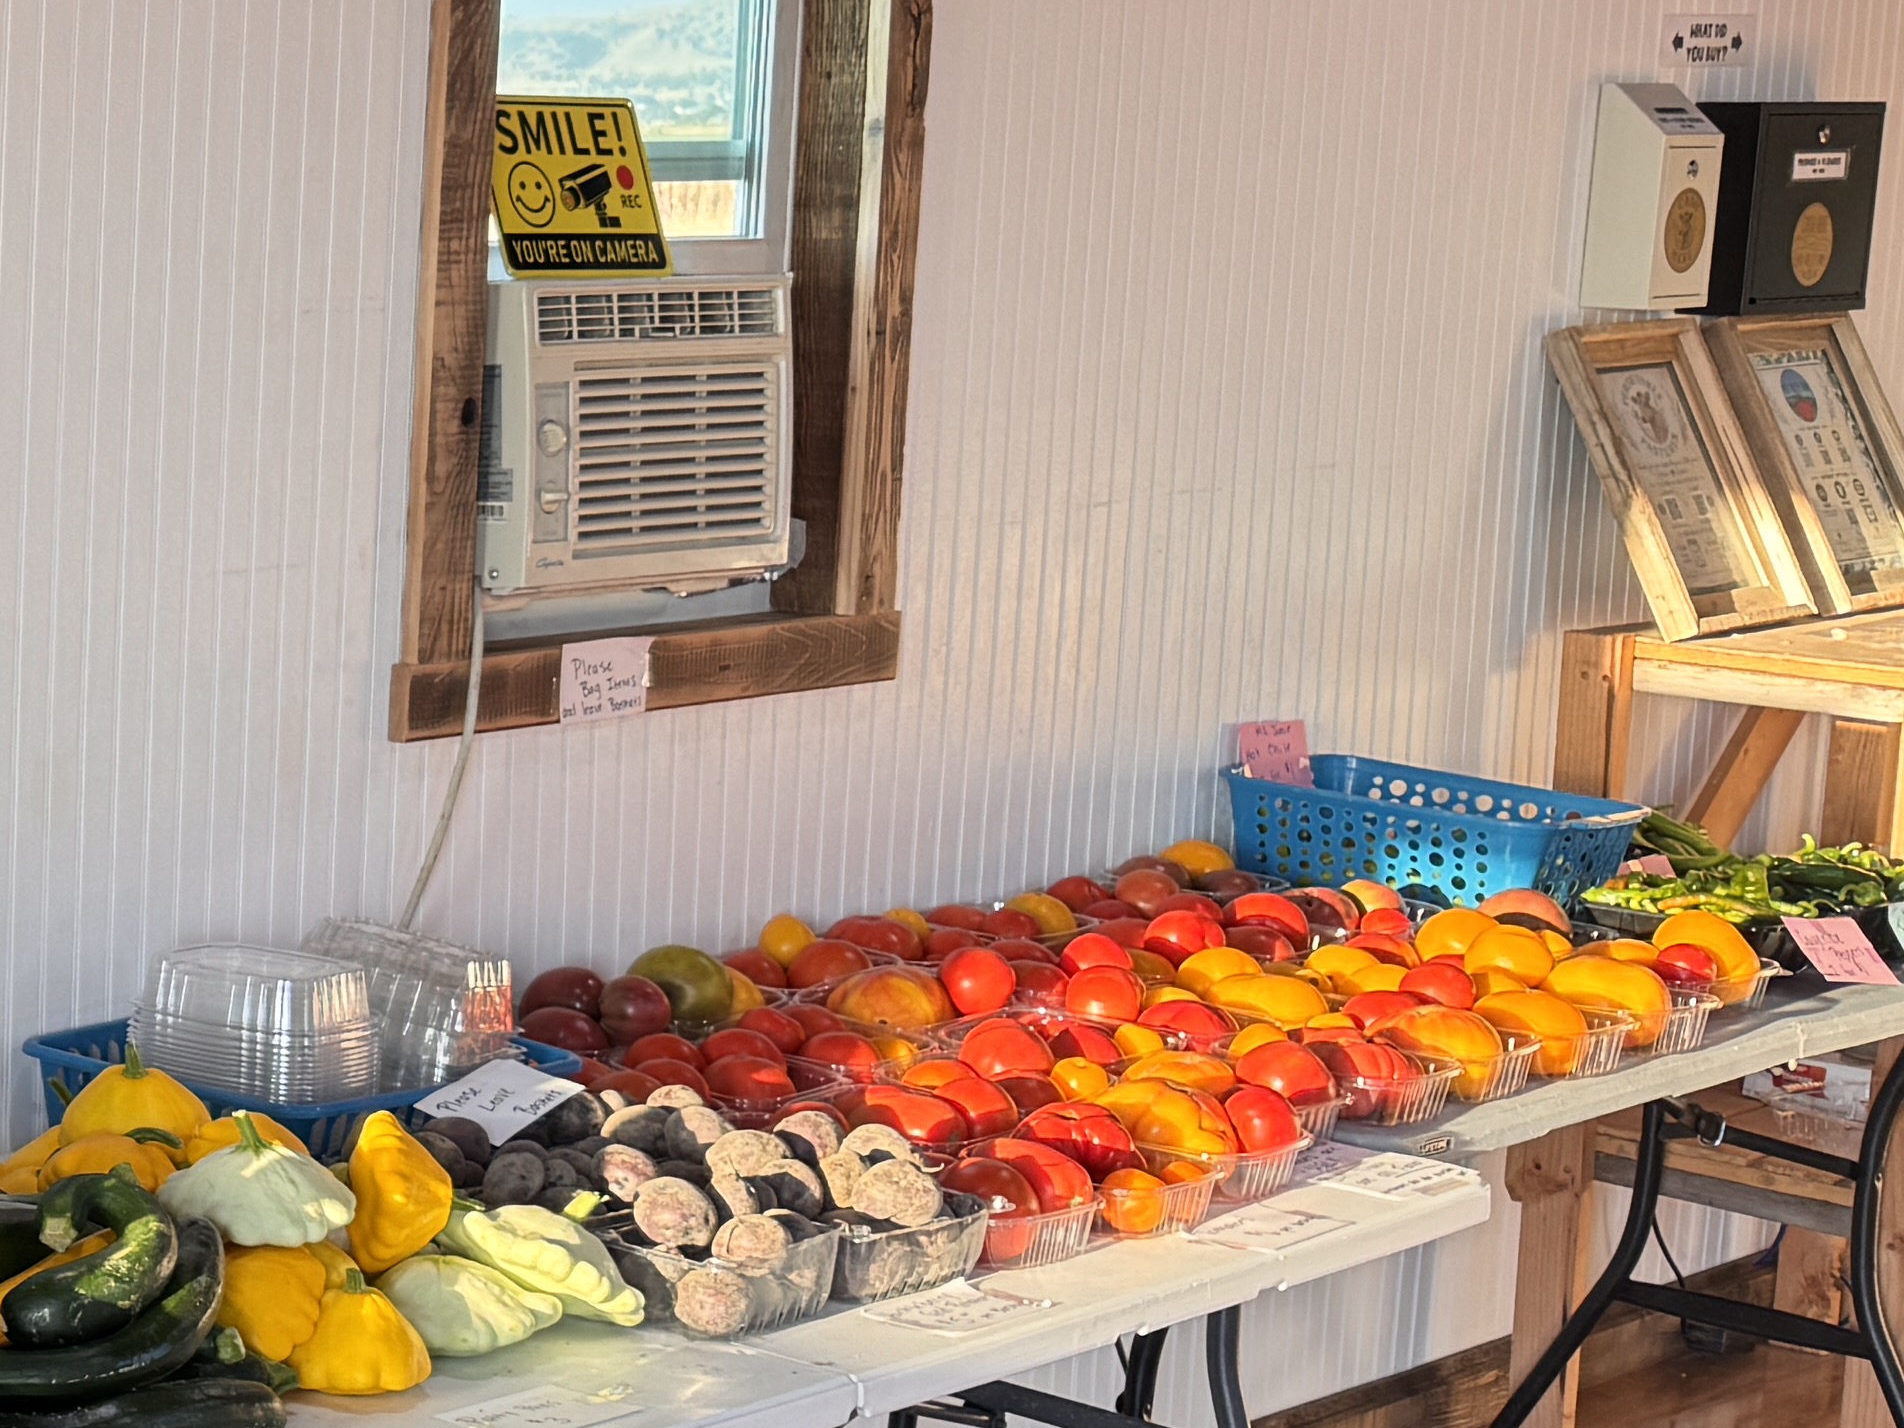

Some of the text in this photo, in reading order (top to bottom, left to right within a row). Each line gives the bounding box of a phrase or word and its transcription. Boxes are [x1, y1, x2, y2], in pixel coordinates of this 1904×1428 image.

[495, 109, 627, 157] SMILE!
[620, 194, 642, 209] REC
[512, 239, 659, 263] YOU'RE ON CAMERA
[571, 658, 613, 680] Please
[579, 681, 602, 700] Bag
[435, 1087, 482, 1113] Please
